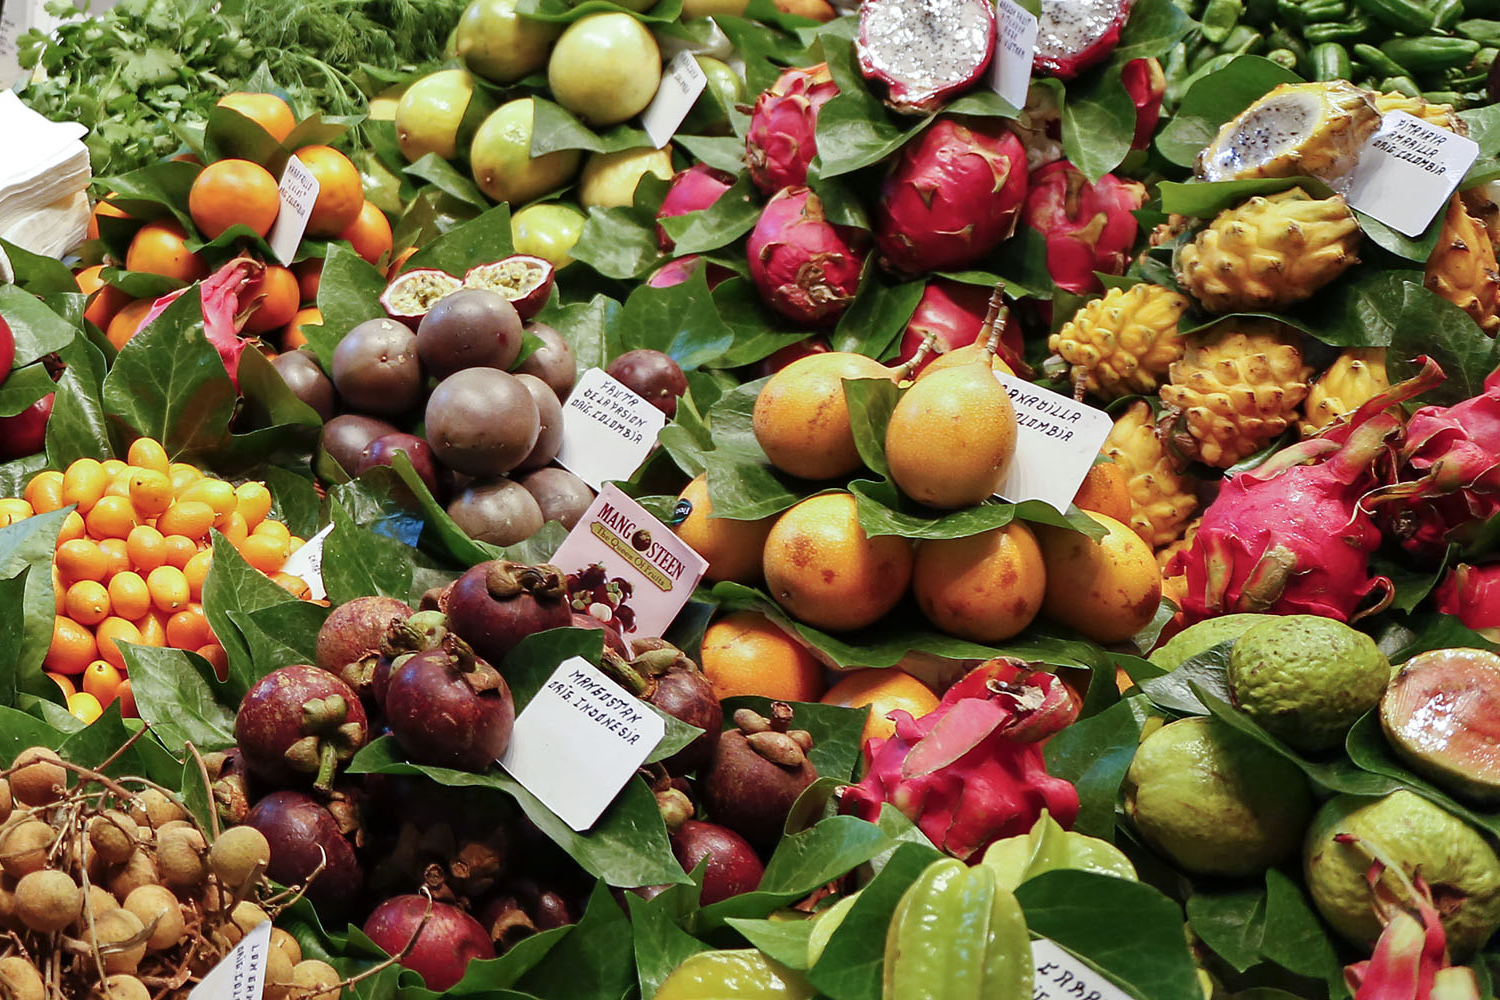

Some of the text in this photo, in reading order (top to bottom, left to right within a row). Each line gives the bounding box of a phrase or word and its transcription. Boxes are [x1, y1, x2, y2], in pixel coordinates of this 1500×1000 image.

[1387, 130, 1439, 160] AMARILLA
[1394, 149, 1448, 177] COLOMBIA
[599, 380, 640, 408] FRUTA
[591, 410, 644, 445] COLOMBIA
[1014, 410, 1075, 443] OLOMBIA
[596, 526, 611, 542] The
[610, 537, 638, 564] Queen
[644, 566, 666, 588] Fruits
[568, 669, 642, 724] MANGOSTAN
[572, 695, 641, 746] INDONESIA
[231, 972, 245, 1000] COL
